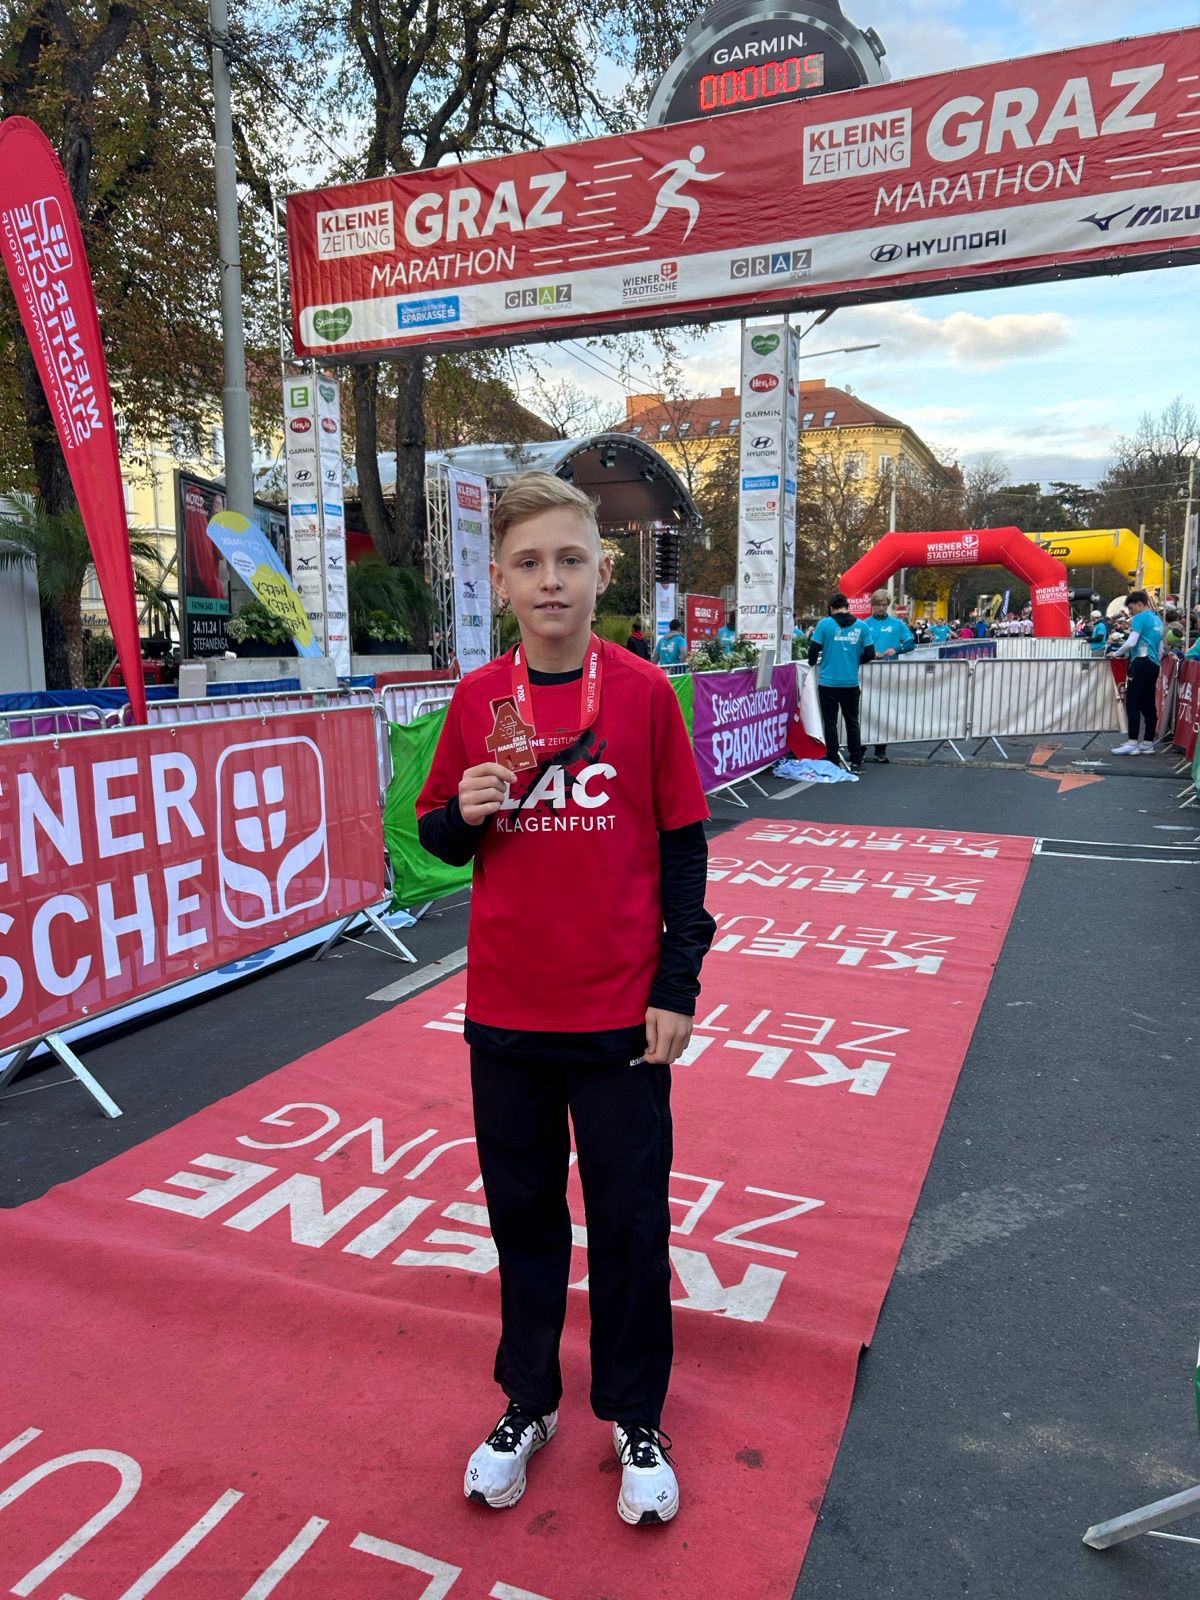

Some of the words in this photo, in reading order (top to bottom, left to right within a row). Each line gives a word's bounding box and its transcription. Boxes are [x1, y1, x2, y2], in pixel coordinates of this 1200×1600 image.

[714, 32, 803, 64] GARMIN
[926, 63, 1166, 162] GRAZ
[808, 116, 906, 152] KLEINE
[808, 141, 906, 176] ZEITUNG
[874, 155, 1086, 216] MARATHON
[321, 208, 390, 234] KLEINE
[404, 170, 567, 248] GRAZ
[321, 227, 391, 255] ZEITUNG
[906, 229, 1006, 258] HYUNDAI
[370, 244, 516, 290] MARATHON
[732, 250, 811, 278] GRAZ
[789, 269, 812, 280] SPORT
[622, 274, 660, 287] WIENER
[506, 285, 571, 308] GRAZ
[402, 310, 447, 324] SPARKASSE
[752, 377, 776, 388] Hervis
[745, 410, 780, 418] GARMIN
[746, 450, 777, 458] HYUNDAI
[927, 542, 962, 552] WIENER
[1036, 587, 1059, 595] WIENER
[192, 620, 217, 634] 24.11.24
[463, 648, 486, 656] GARMIN
[588, 652, 598, 680] KLEINE
[516, 684, 526, 702] 2024
[586, 680, 596, 713] ZEITUNG
[498, 740, 526, 752] MARATHON
[512, 735, 526, 743] GRAZ
[712, 716, 778, 776] SPARKASSE
[496, 815, 616, 833] KLAGENFURT
[762, 824, 1003, 848] ZEITUNG
[746, 832, 1000, 858] KLEINE
[708, 857, 984, 891] ZEITUNG
[714, 912, 956, 954] ZEITU
[710, 934, 945, 975] KLEI
